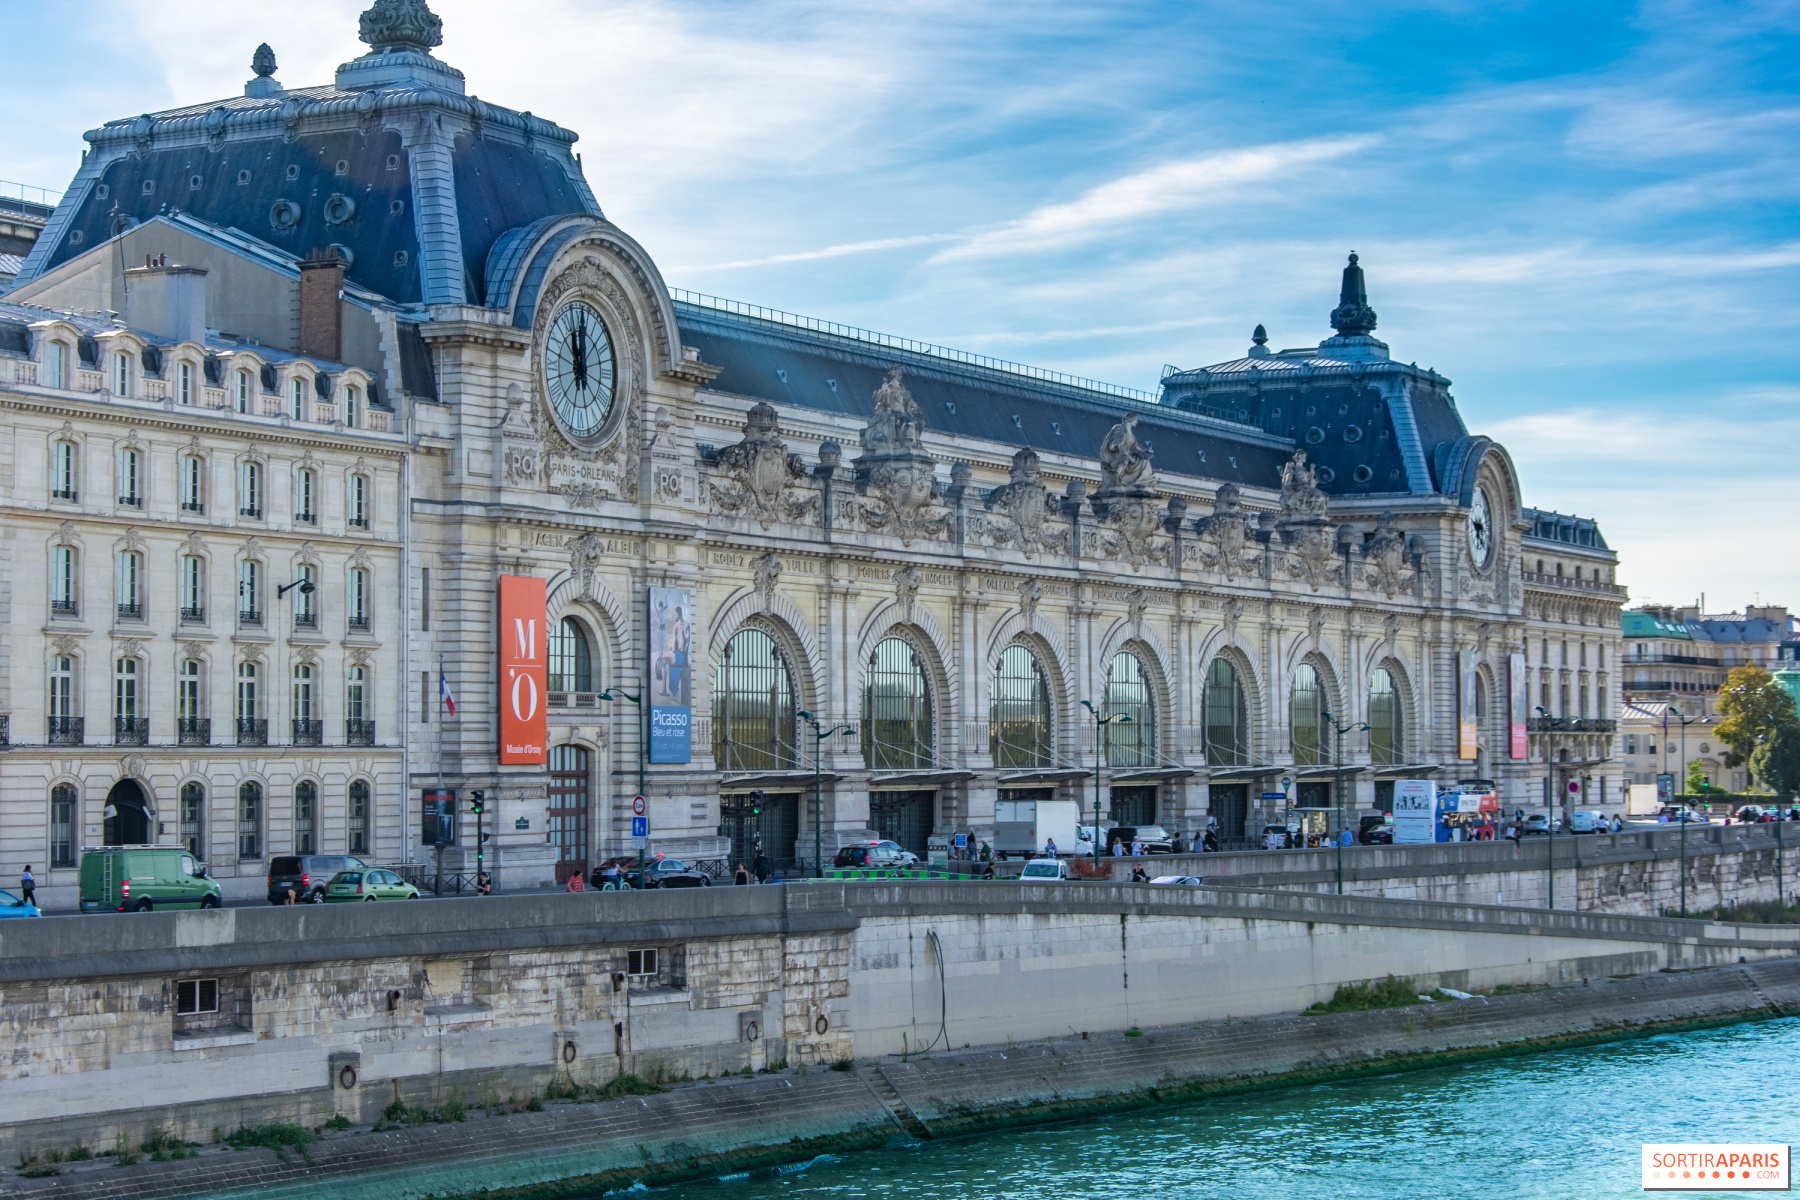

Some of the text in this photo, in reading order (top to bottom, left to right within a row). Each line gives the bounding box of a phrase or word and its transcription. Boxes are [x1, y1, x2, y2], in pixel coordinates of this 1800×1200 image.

[512, 454, 532, 474] PO
[552, 462, 616, 482] PARIS-ORLEANS
[660, 474, 678, 492] PO
[714, 552, 744, 568] RODEZ
[786, 560, 816, 574] TULLE
[513, 618, 537, 660] M
[652, 710, 688, 726] Picasso
[652, 726, 665, 736] Bleu
[666, 728, 672, 736] et
[506, 744, 542, 755] Musée d'Orsay
